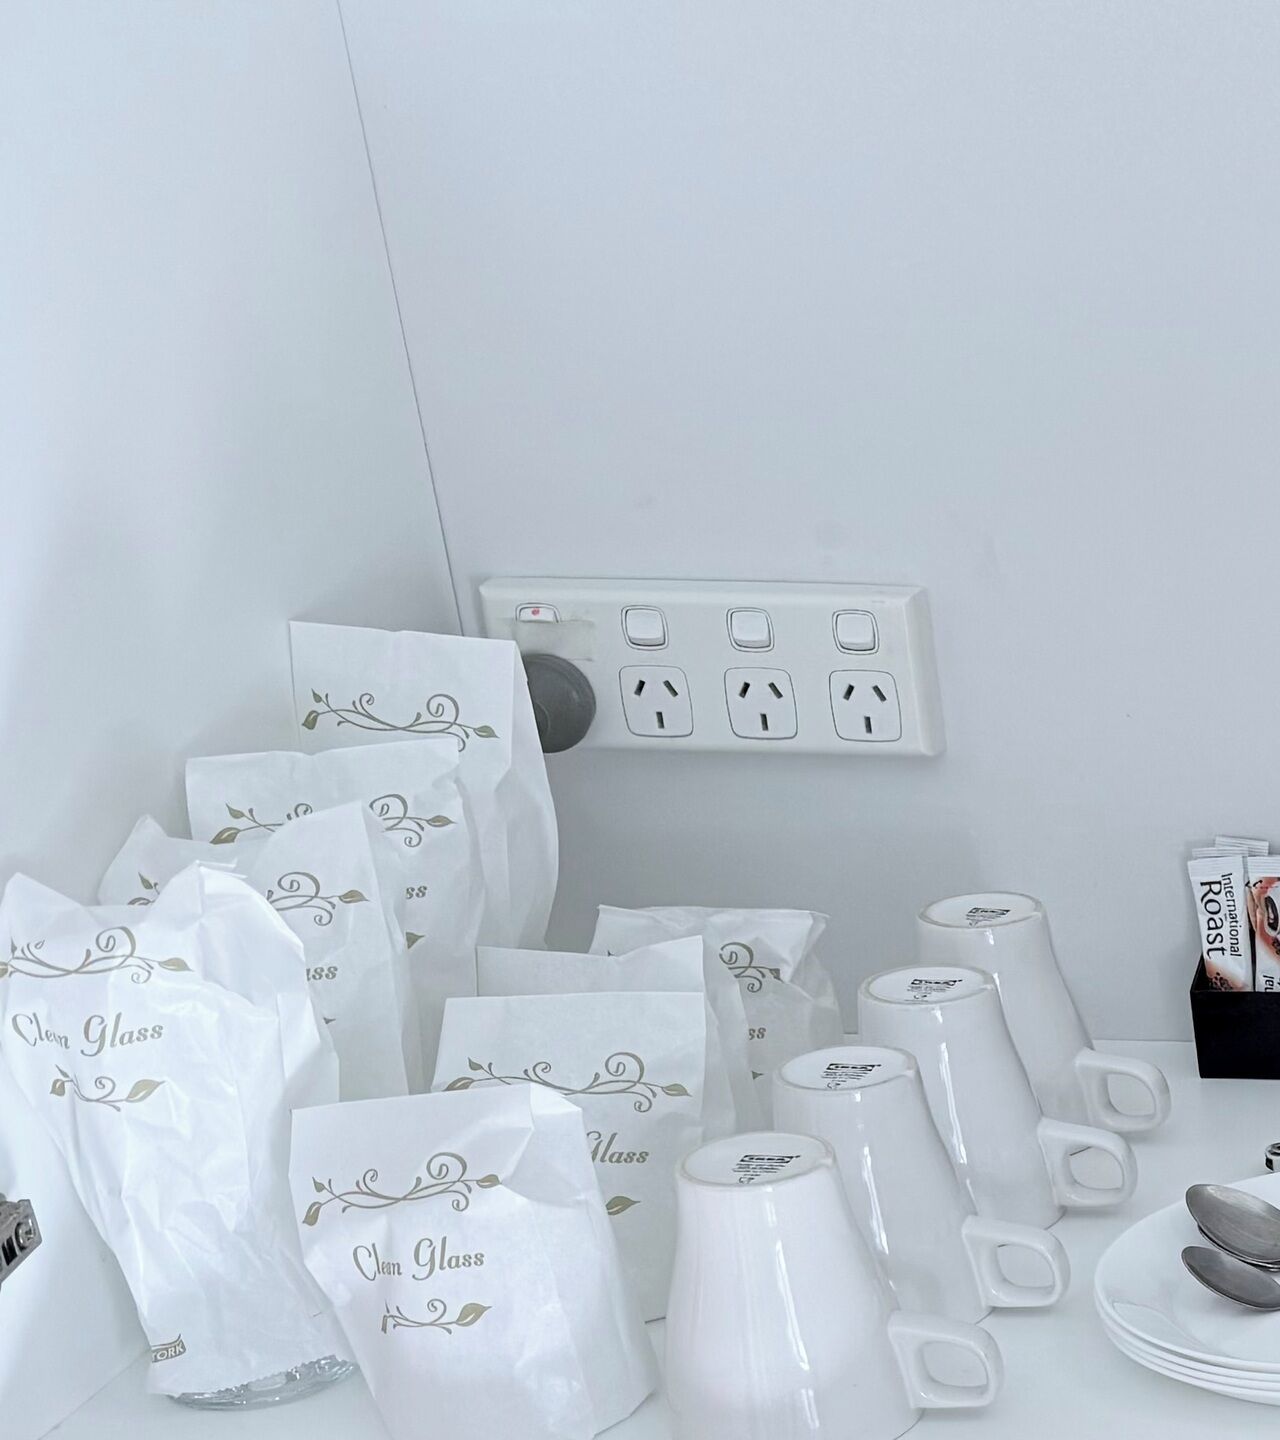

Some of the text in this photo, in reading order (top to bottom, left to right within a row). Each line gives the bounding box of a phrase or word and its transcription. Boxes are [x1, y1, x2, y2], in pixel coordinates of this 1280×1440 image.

[1200, 880, 1226, 959] Roast
[1221, 872, 1242, 957] International
[80, 1011, 164, 1058] Glass
[352, 1235, 485, 1282] Clean Glass
